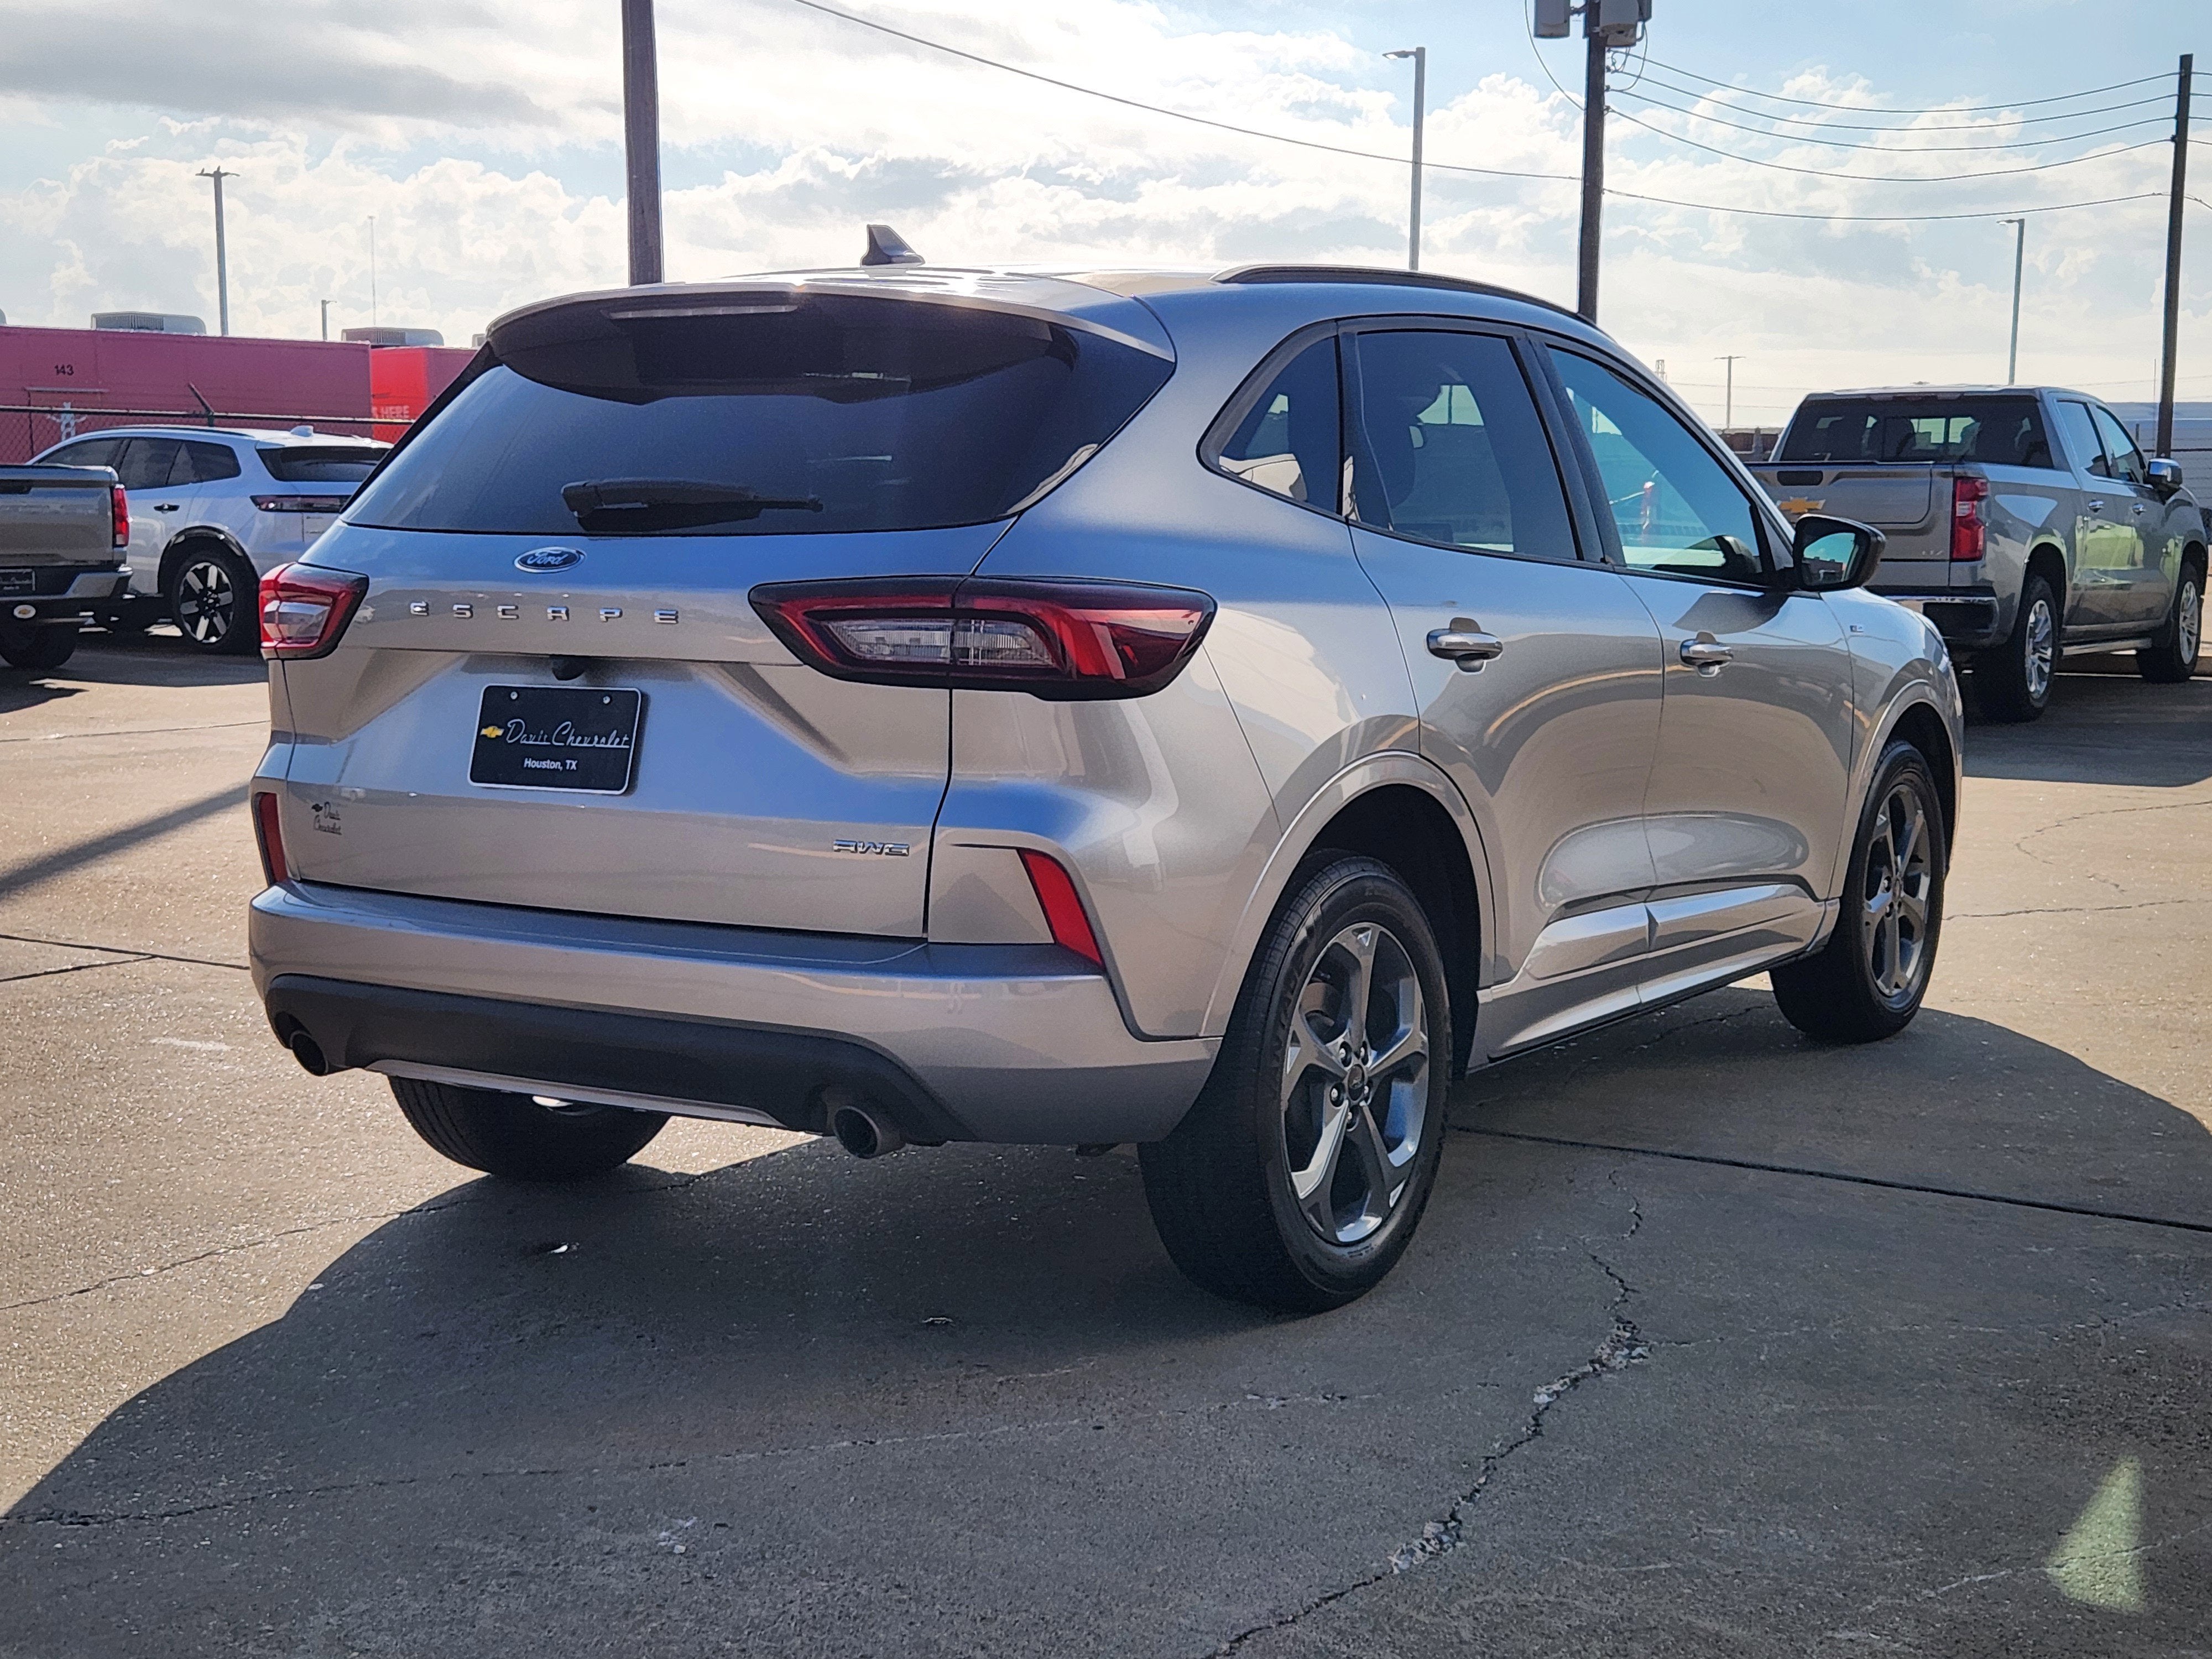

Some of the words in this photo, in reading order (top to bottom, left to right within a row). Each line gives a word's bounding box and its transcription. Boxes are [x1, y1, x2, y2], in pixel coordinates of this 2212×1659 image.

[55, 364, 74, 375] 143
[526, 549, 568, 565] Ford
[410, 601, 679, 624] ESCAPE
[506, 718, 551, 745] Davis
[552, 721, 630, 748] Chevrolet
[523, 758, 563, 772] Houston,
[565, 759, 578, 770] TX
[833, 839, 910, 856] AWD
